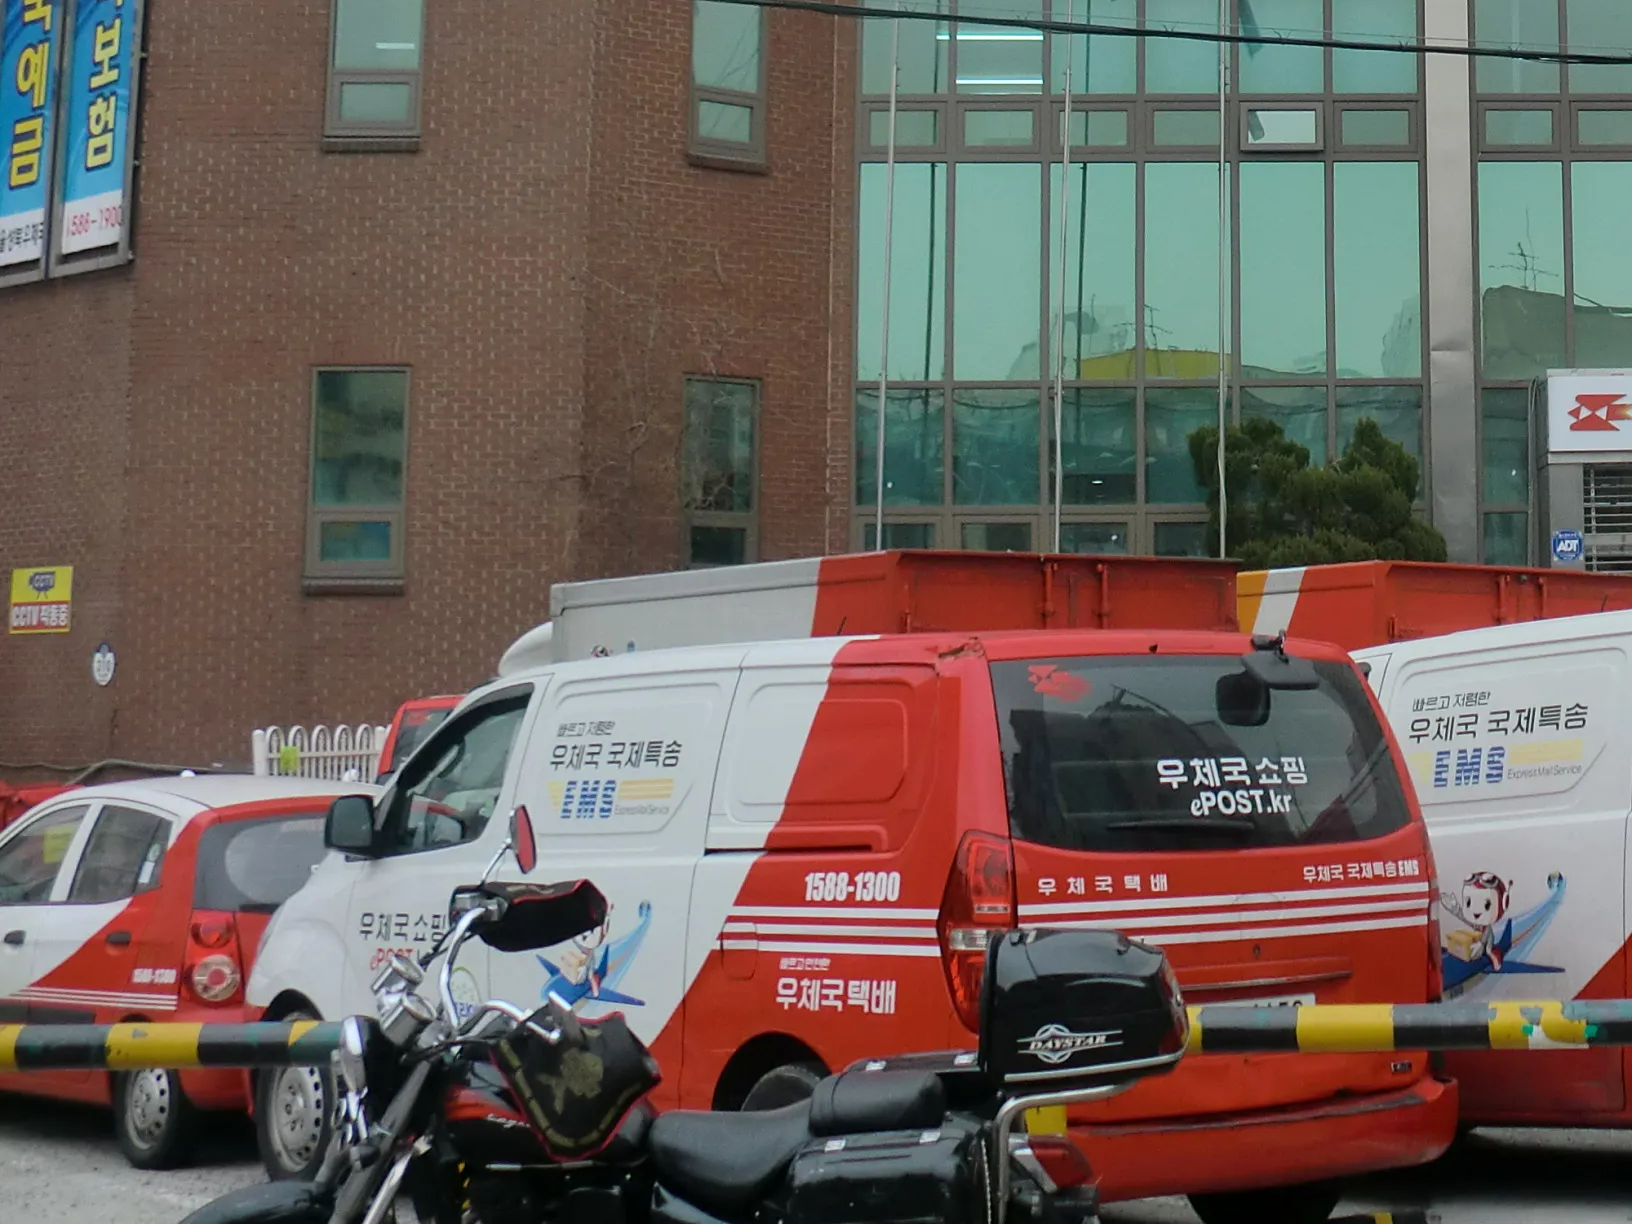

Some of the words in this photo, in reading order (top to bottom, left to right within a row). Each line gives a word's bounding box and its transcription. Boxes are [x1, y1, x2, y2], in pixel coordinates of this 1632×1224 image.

[1557, 539, 1579, 552] ADT
[12, 605, 40, 627] CCTV
[1412, 693, 1451, 713] 빠르고
[1452, 690, 1492, 708] 저렴한
[1408, 712, 1479, 744] 우체국
[1487, 702, 1589, 737] 국제특송
[550, 742, 603, 771] 우체국
[606, 739, 683, 769] 국제특송
[1433, 745, 1506, 788] EMS
[560, 779, 617, 819] EMS
[1190, 788, 1294, 816] ePOST.kr
[804, 871, 902, 902] 1588-1300
[1302, 863, 1345, 884] 우체국
[1029, 1035, 1107, 1051] DAYSTAR
